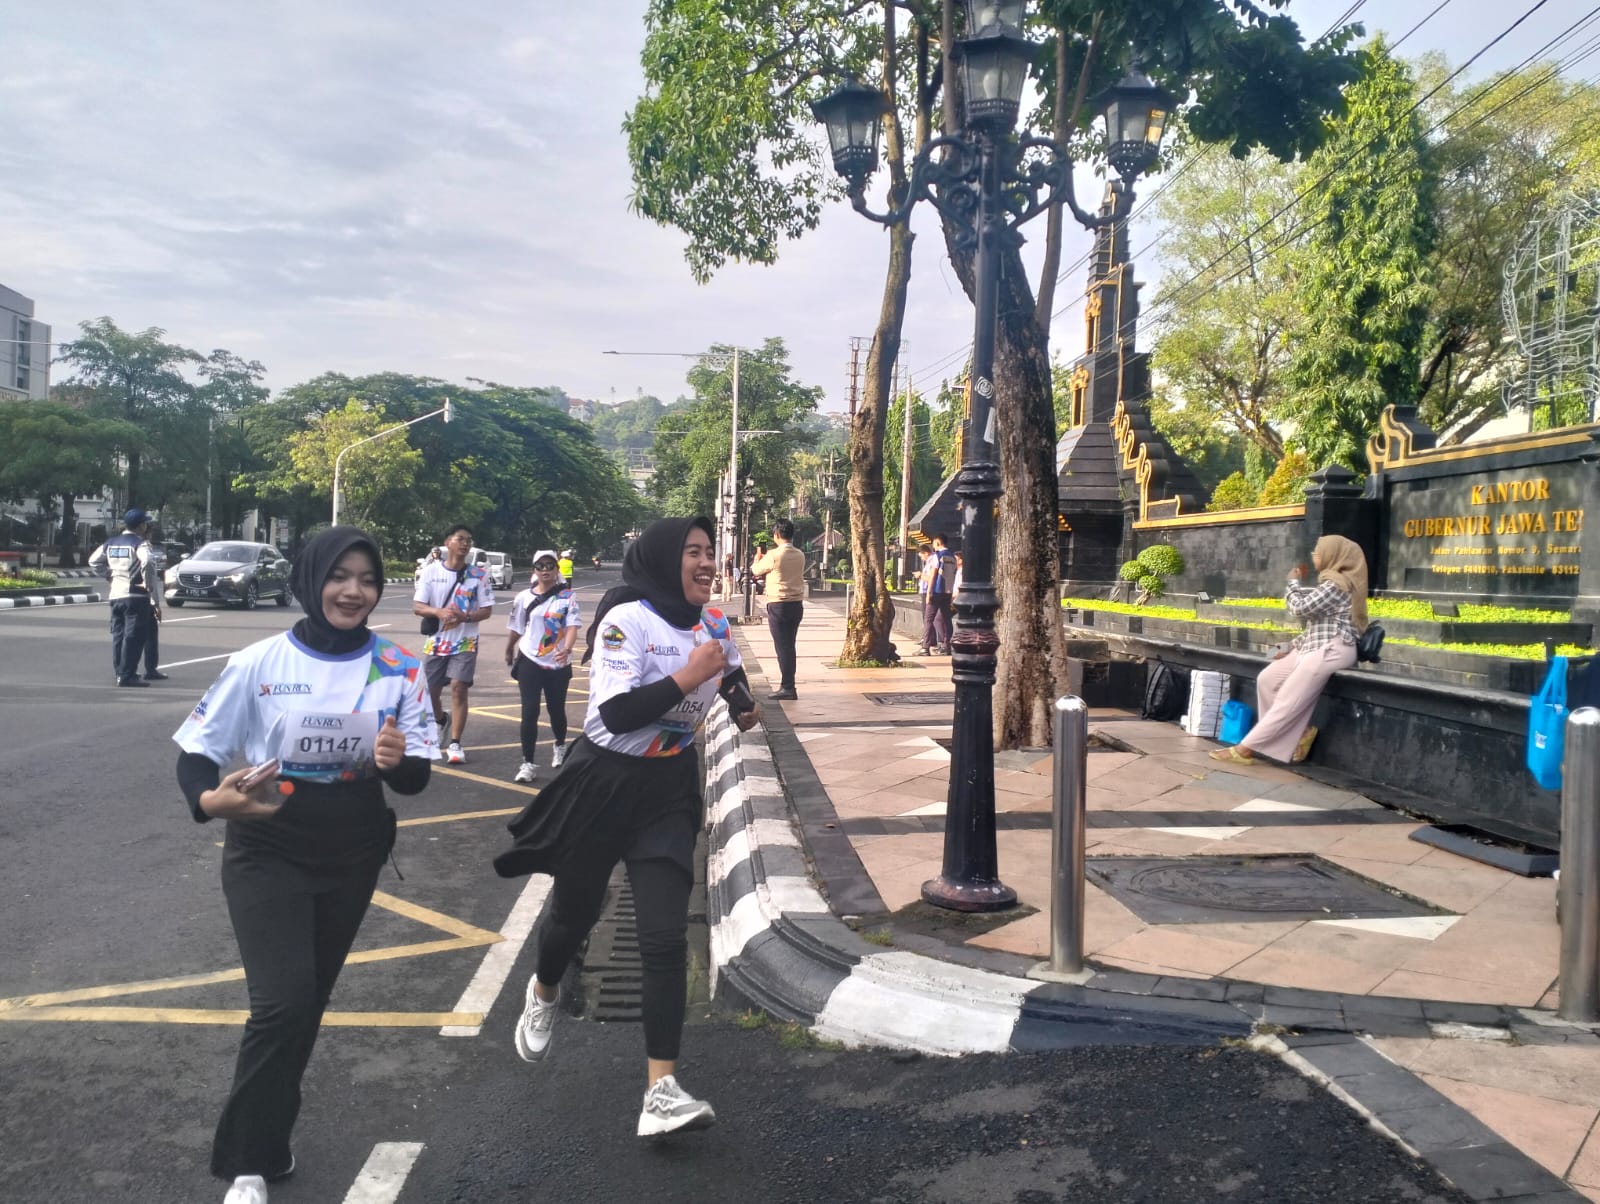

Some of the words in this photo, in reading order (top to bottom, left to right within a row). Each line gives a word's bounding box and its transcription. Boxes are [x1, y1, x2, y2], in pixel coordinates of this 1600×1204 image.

[1471, 479, 1549, 505] KANTOR
[1404, 514, 1491, 538] GUBERNUR
[1496, 512, 1547, 535] JAWA
[1430, 546, 1451, 555] Jalan
[300, 737, 361, 753] 01147
